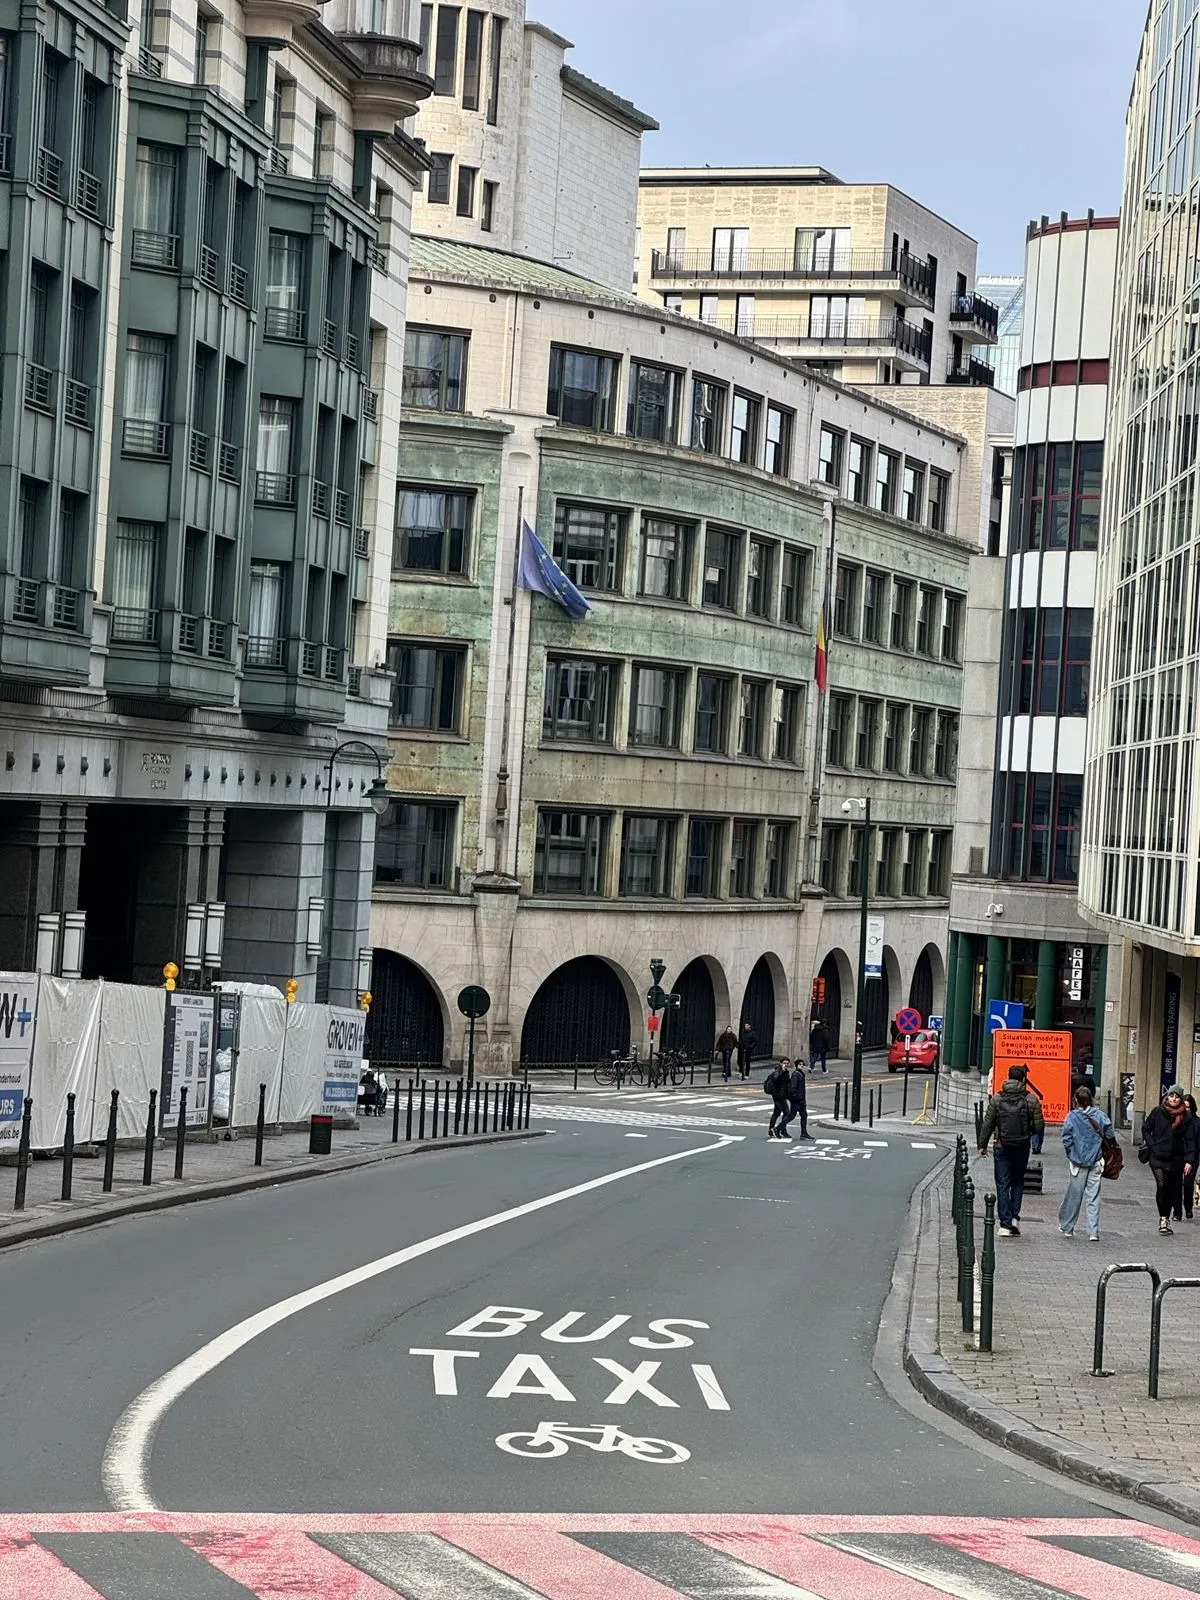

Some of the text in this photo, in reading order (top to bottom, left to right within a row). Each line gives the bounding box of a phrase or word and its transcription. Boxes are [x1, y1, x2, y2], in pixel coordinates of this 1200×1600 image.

[1073, 949, 1081, 988] CAFE
[1168, 992, 1177, 1023] PARKING
[1001, 1041, 1036, 1050] Gewijzigde
[1006, 1049, 1027, 1057] Bright
[1166, 1025, 1175, 1053] PRIVATE
[1164, 1058, 1173, 1074] NBB
[445, 1305, 711, 1349] BUS
[408, 1348, 732, 1410] TAXI
